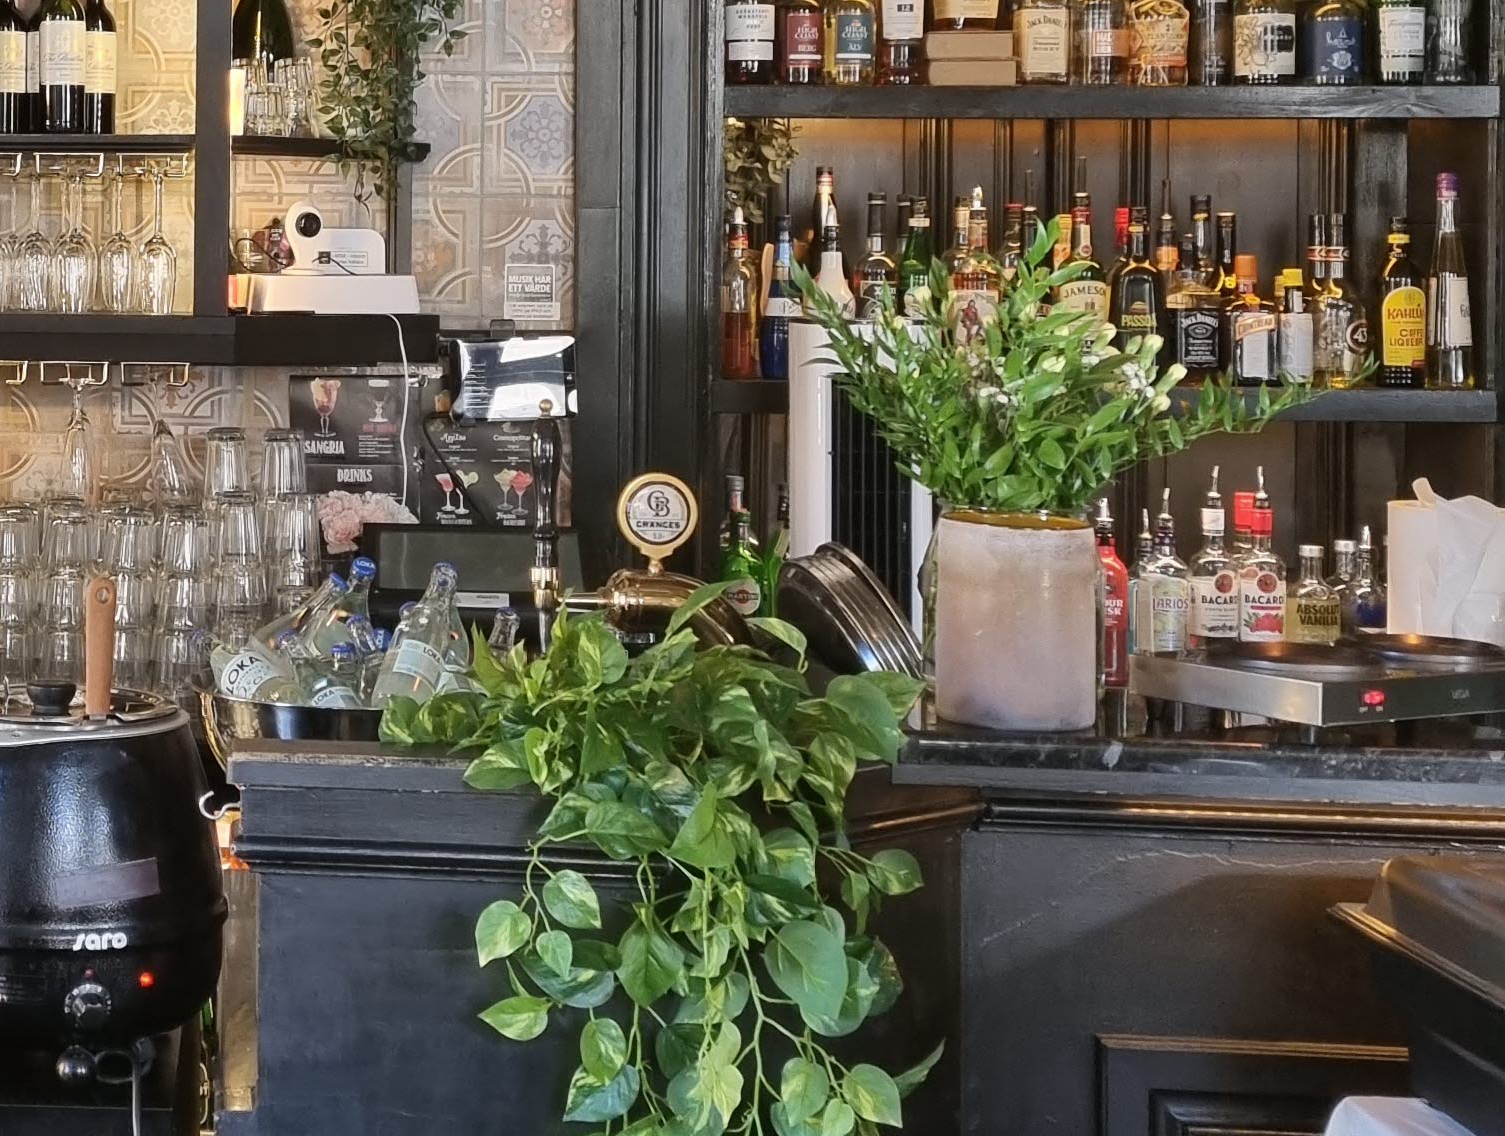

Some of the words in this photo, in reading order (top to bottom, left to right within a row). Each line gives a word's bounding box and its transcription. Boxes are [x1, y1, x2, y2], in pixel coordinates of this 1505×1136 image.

[508, 284, 522, 292] ETT
[1064, 286, 1106, 298] JAMESO
[1352, 327, 1368, 343] 43
[304, 440, 345, 454] SANGRIA
[336, 468, 373, 482] DRINKS
[1152, 598, 1189, 610] LARIOS
[1296, 604, 1340, 615] ABSOLUT
[226, 656, 263, 694] LOKA
[314, 690, 335, 705] LOKA
[73, 932, 128, 951] saro
